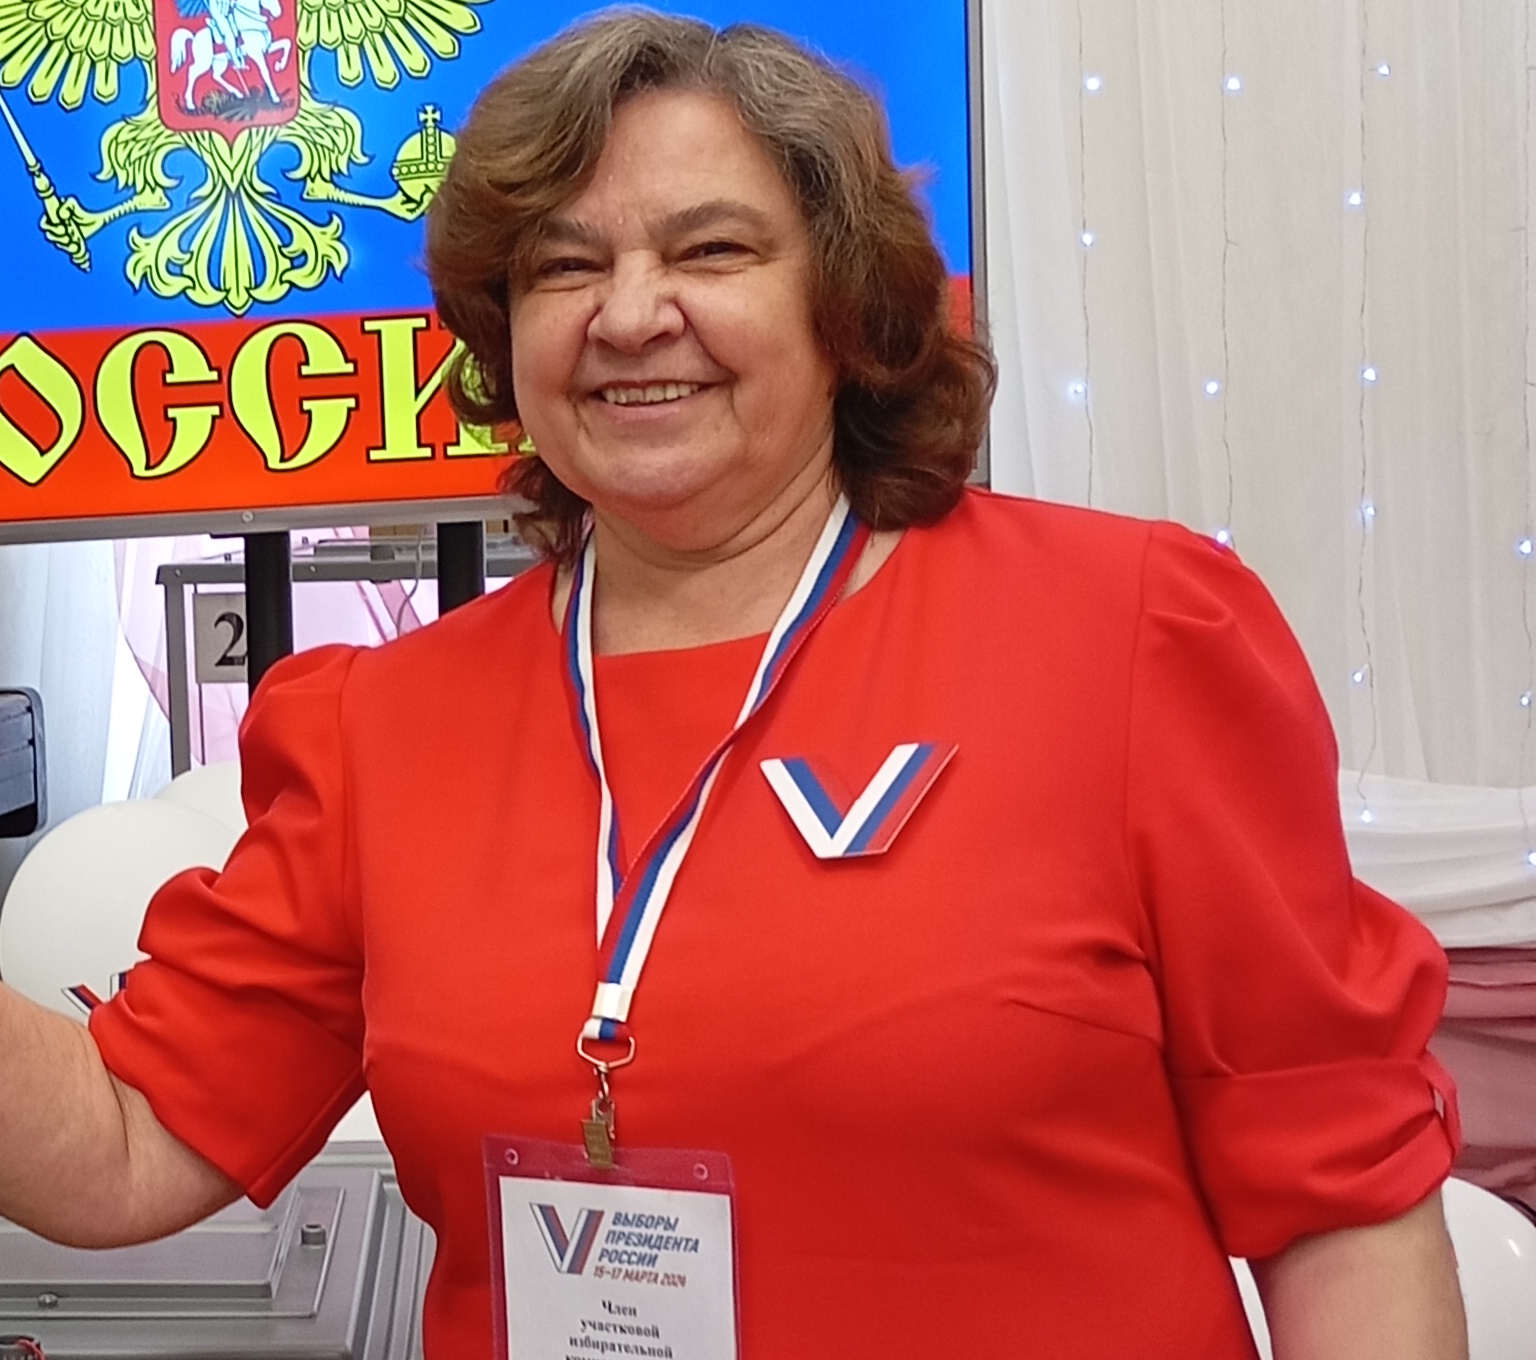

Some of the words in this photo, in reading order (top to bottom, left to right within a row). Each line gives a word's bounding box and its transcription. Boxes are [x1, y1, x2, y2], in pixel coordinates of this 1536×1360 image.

[612, 1212, 679, 1232] ВЫБОРЫ
[605, 1230, 699, 1253] ПРЕЗИДЕНТА
[598, 1248, 658, 1268] РОССИИ
[623, 1269, 659, 1286] МАРТА
[660, 1273, 687, 1288] 2024
[601, 1299, 637, 1317] Член
[580, 1318, 660, 1339] участковой
[568, 1334, 673, 1359] избирательной
